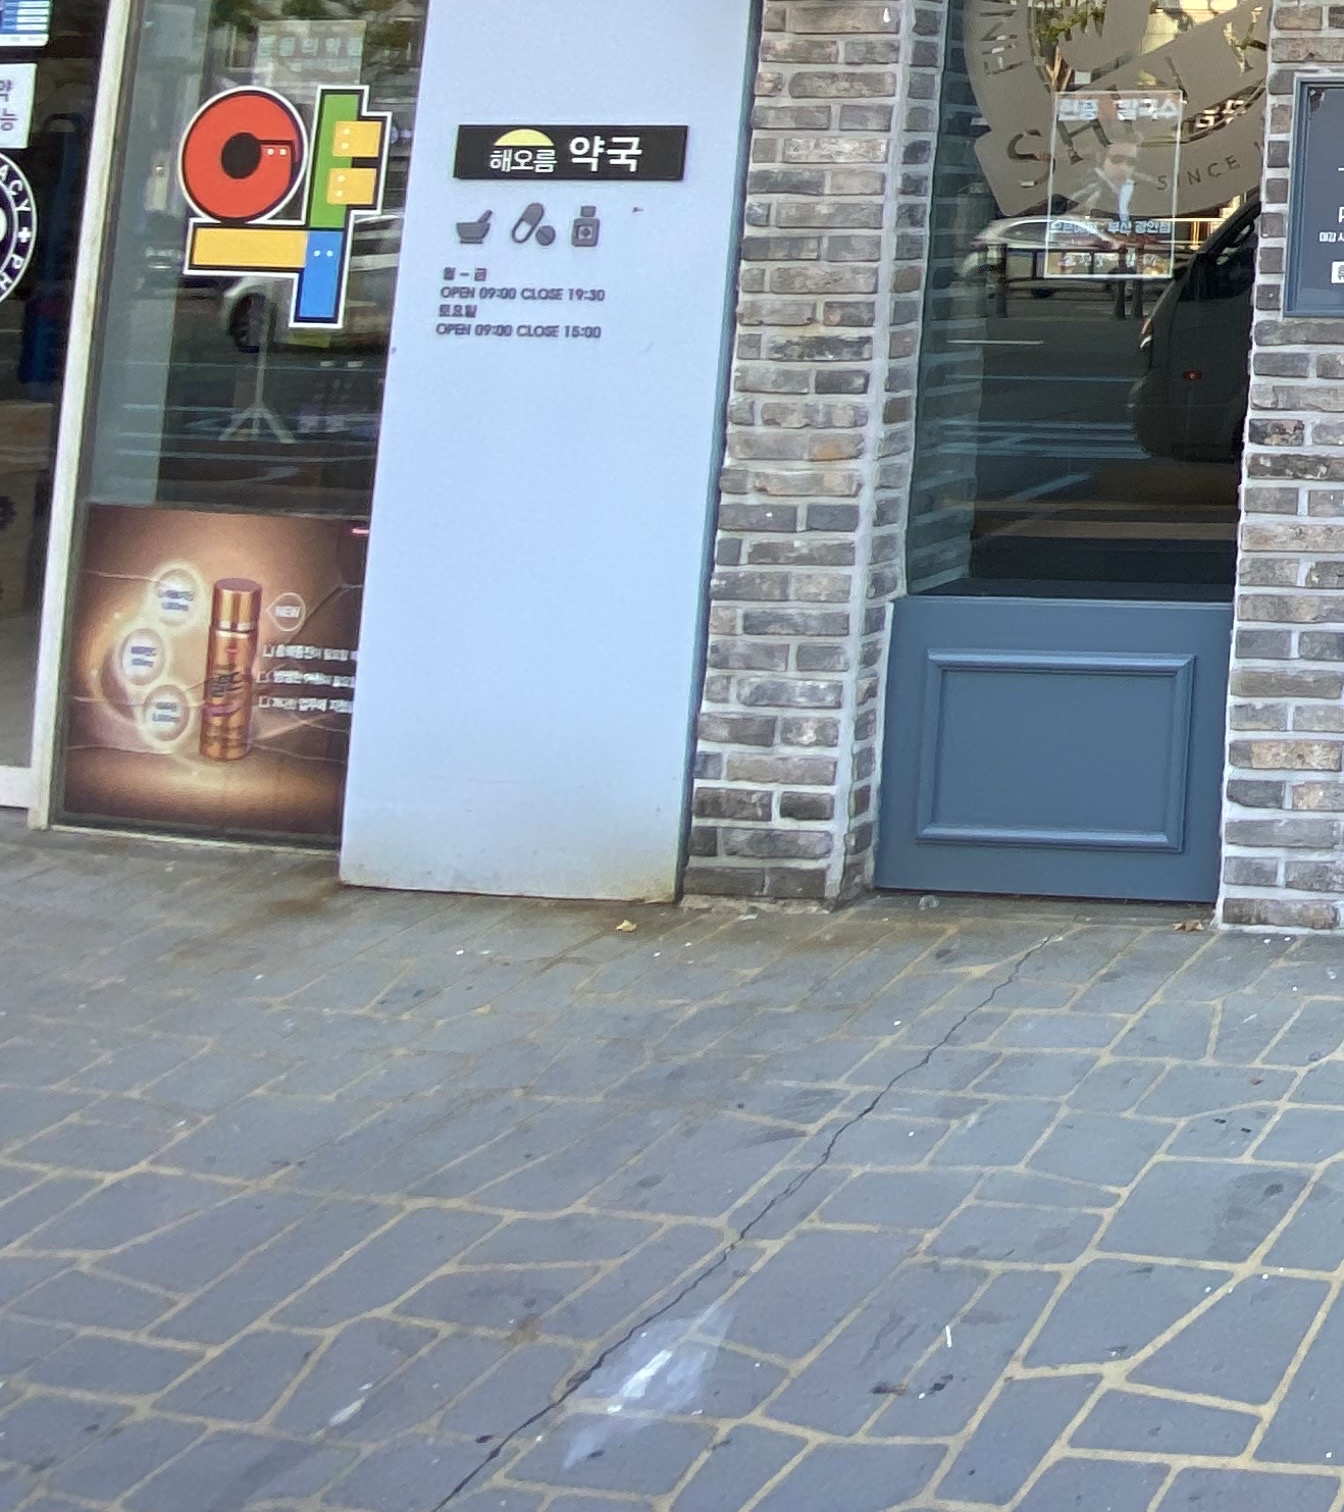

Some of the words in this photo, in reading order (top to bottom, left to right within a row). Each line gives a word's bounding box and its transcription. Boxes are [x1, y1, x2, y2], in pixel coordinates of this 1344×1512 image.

[489, 148, 558, 173] 해오름
[569, 135, 643, 172] 약국
[181, 85, 393, 330] 약
[440, 286, 476, 300] OPEN
[479, 287, 517, 301] 09:00
[521, 287, 564, 302] CLOSE
[569, 288, 606, 303] 19:30
[436, 323, 472, 336] OPEN
[474, 324, 512, 338] 09:00
[516, 324, 560, 338] CLOSE
